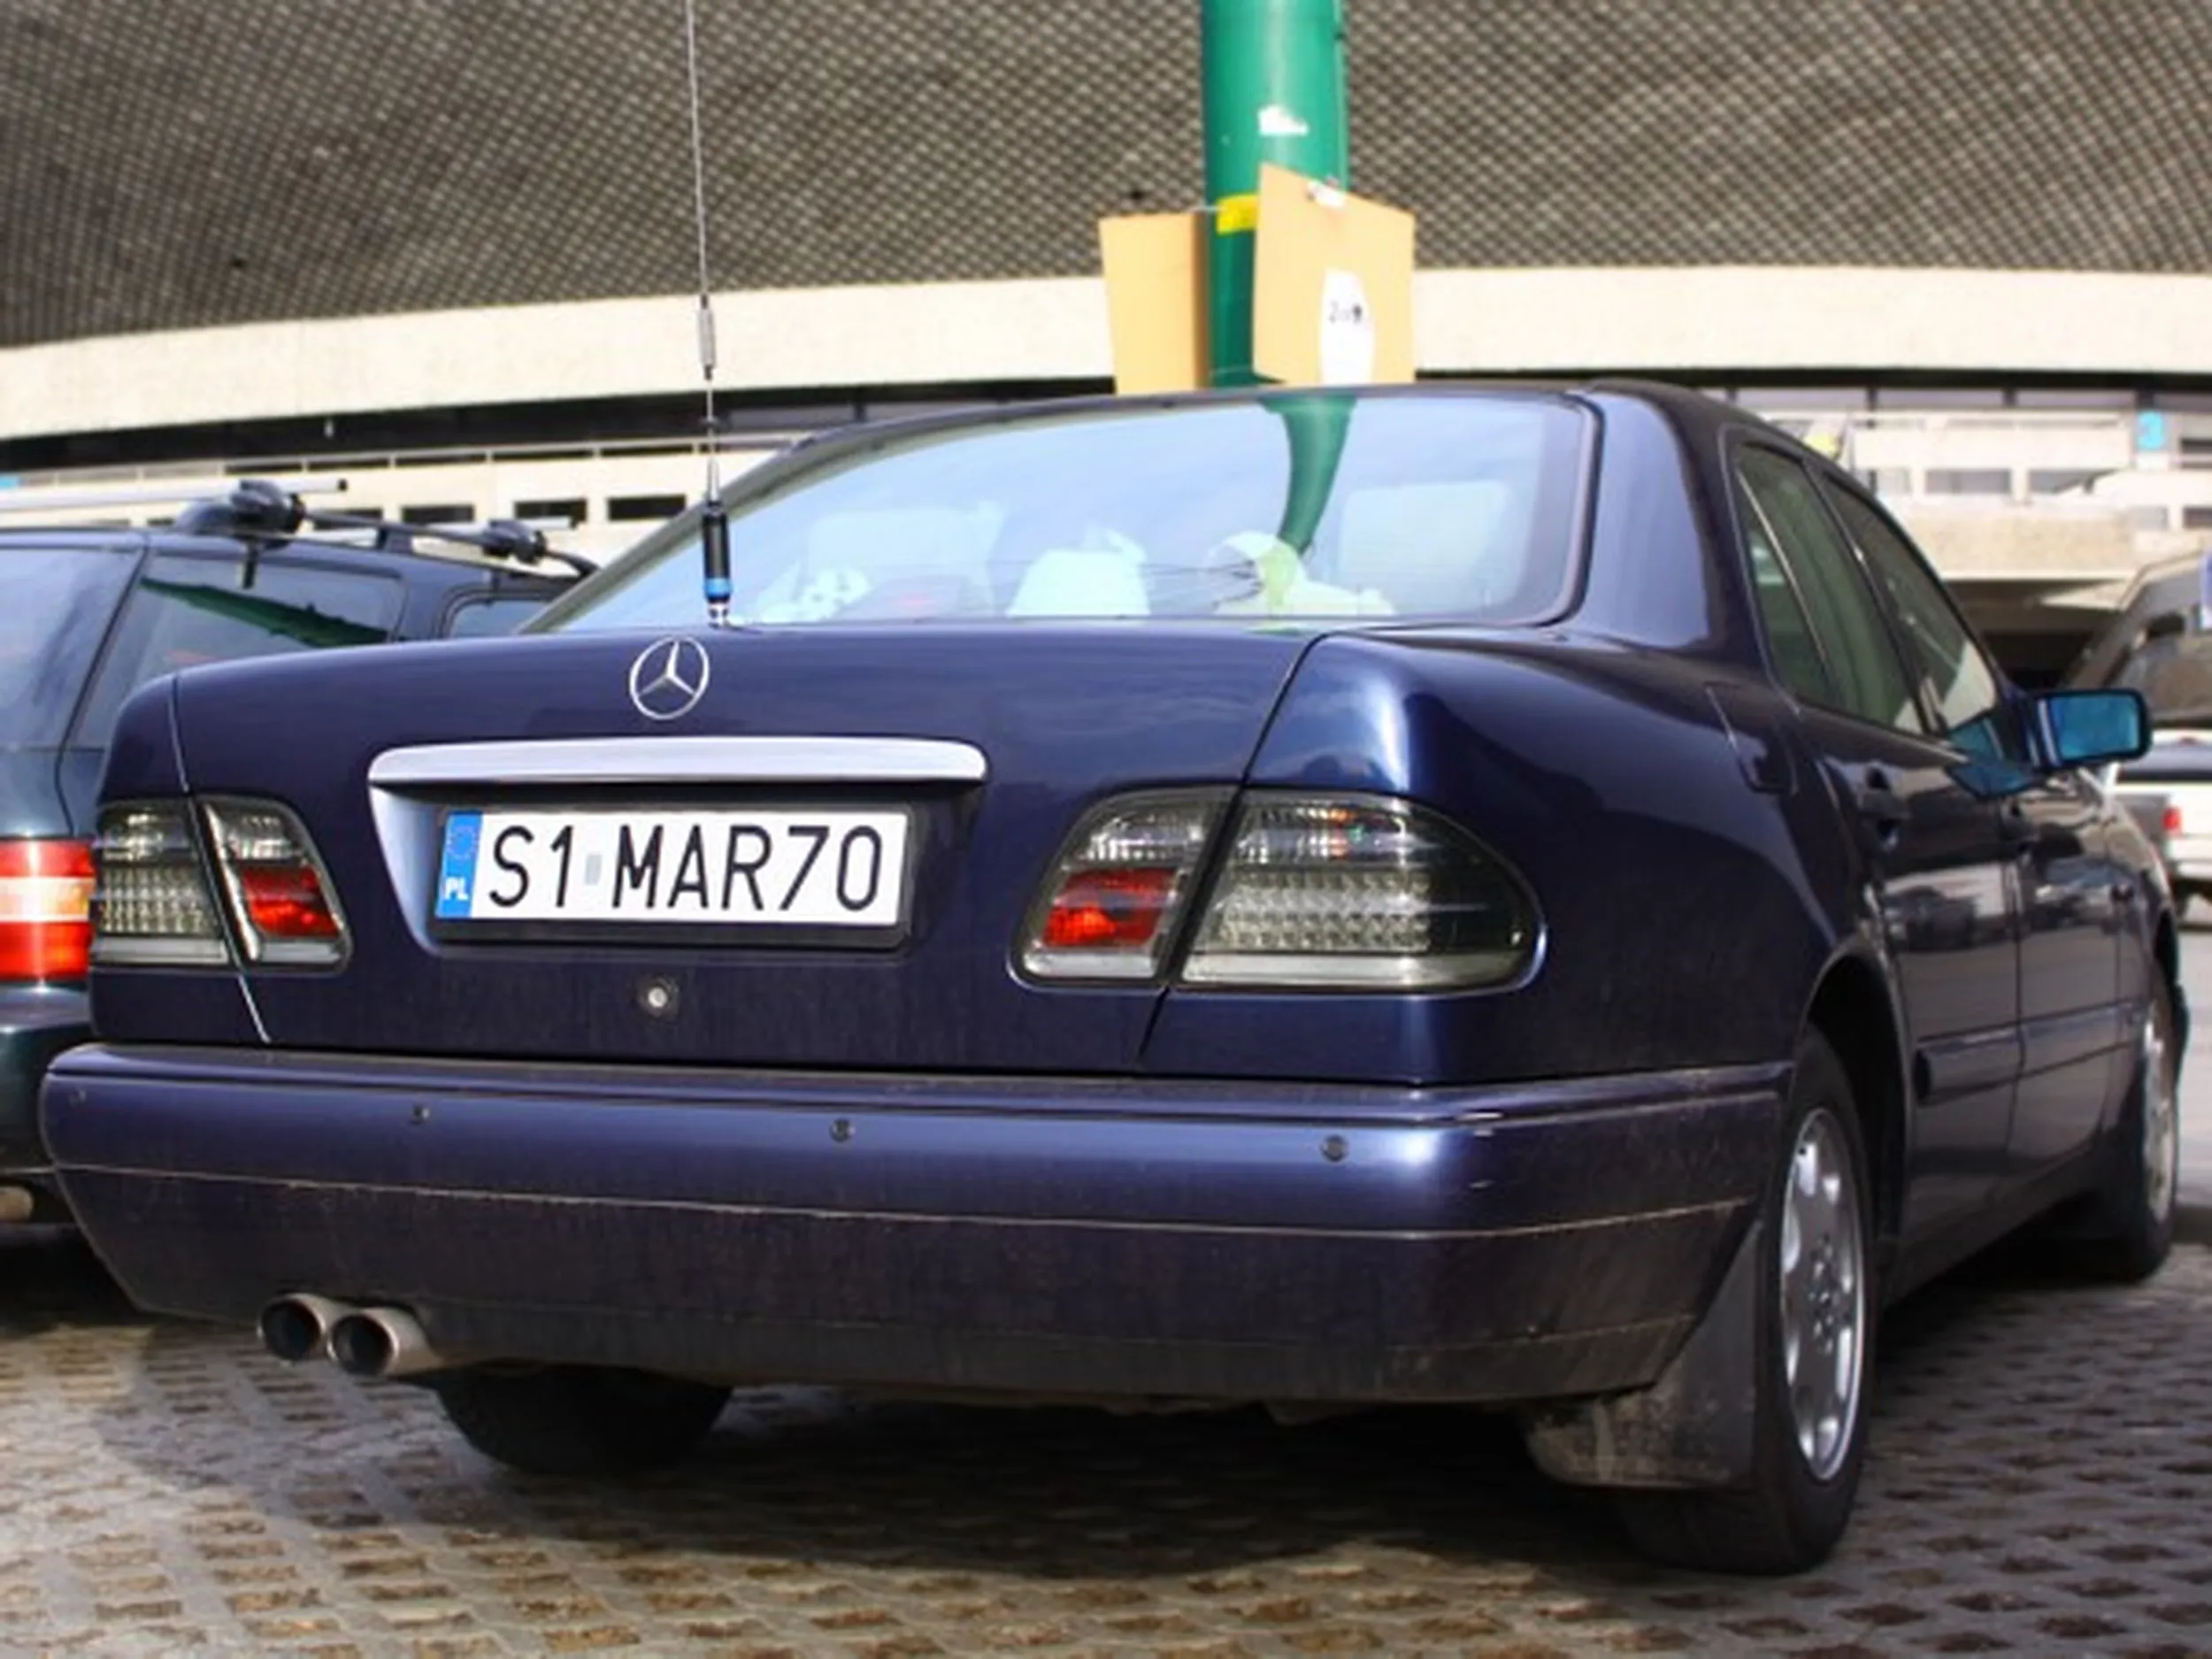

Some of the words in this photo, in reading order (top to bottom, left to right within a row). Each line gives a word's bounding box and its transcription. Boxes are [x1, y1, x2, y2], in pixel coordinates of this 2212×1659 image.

[444, 876, 469, 901] PL
[488, 824, 573, 909] S1
[611, 824, 883, 911] MAR70
